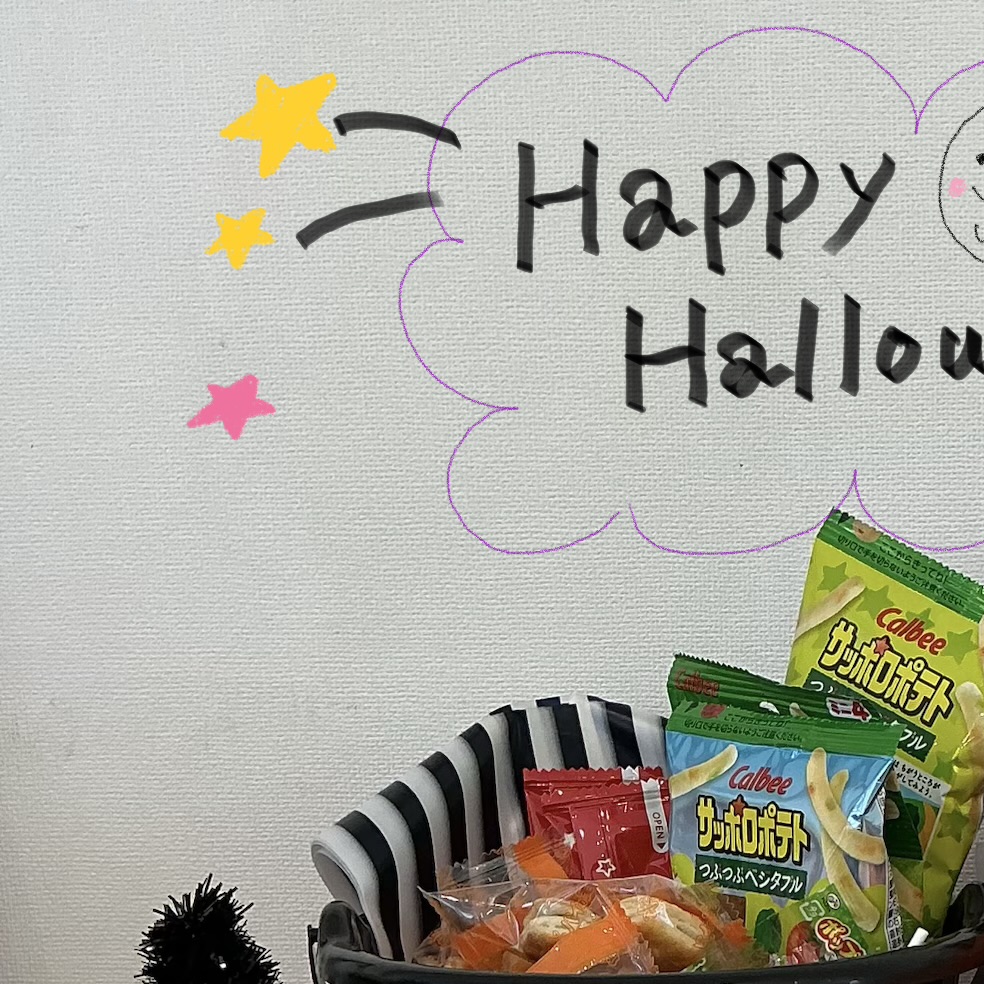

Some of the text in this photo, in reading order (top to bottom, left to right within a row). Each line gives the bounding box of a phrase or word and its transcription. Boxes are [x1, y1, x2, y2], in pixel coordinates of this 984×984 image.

[875, 607, 947, 656] Calbee
[818, 617, 955, 727] サッポロポテト
[727, 765, 794, 796] Calbee
[652, 811, 665, 840] OPEN
[695, 794, 812, 865] サッポロポテト
